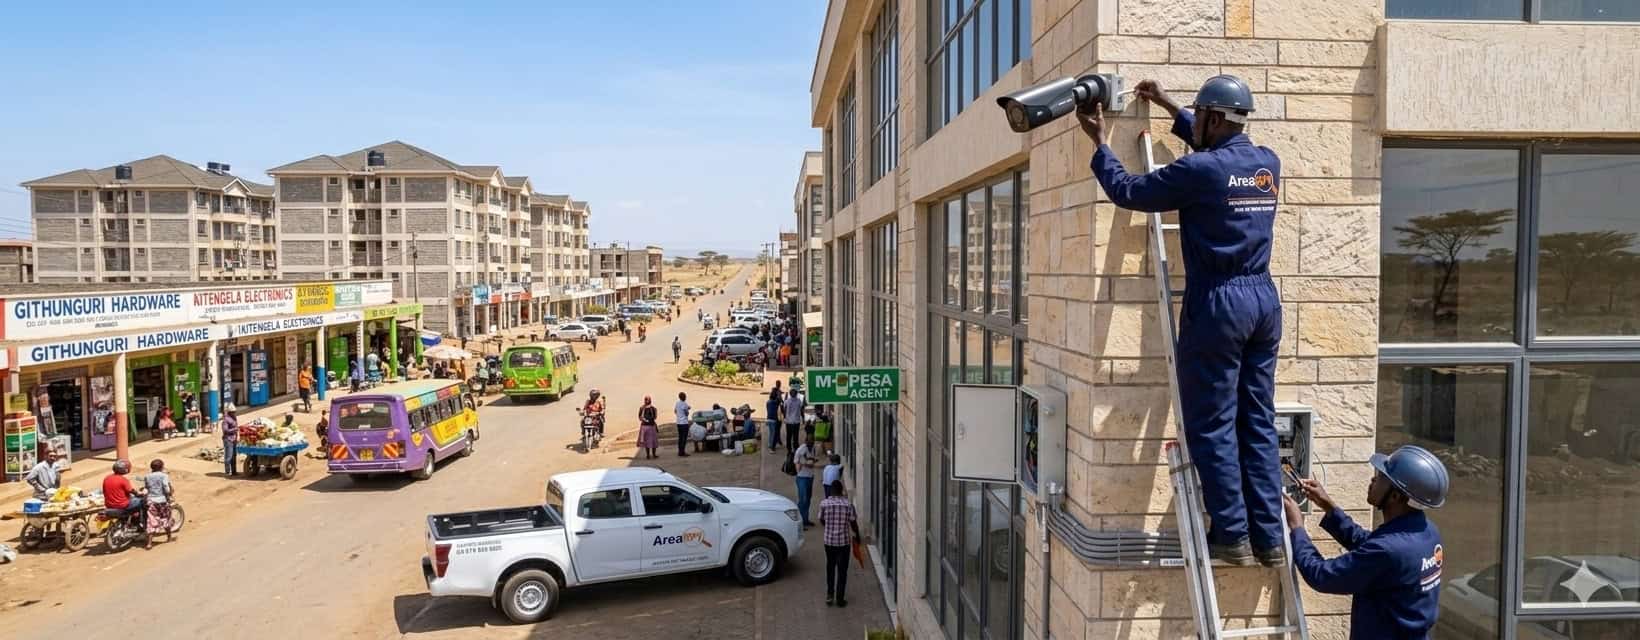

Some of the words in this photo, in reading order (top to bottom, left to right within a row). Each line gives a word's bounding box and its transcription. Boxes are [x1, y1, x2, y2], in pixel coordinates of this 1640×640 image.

[14, 299, 105, 320] GITHUNGURI
[111, 294, 181, 313] HARDWARE
[31, 337, 128, 362] GITHUNGURI
[849, 388, 891, 399] AGENT
[653, 535, 683, 546] Area
